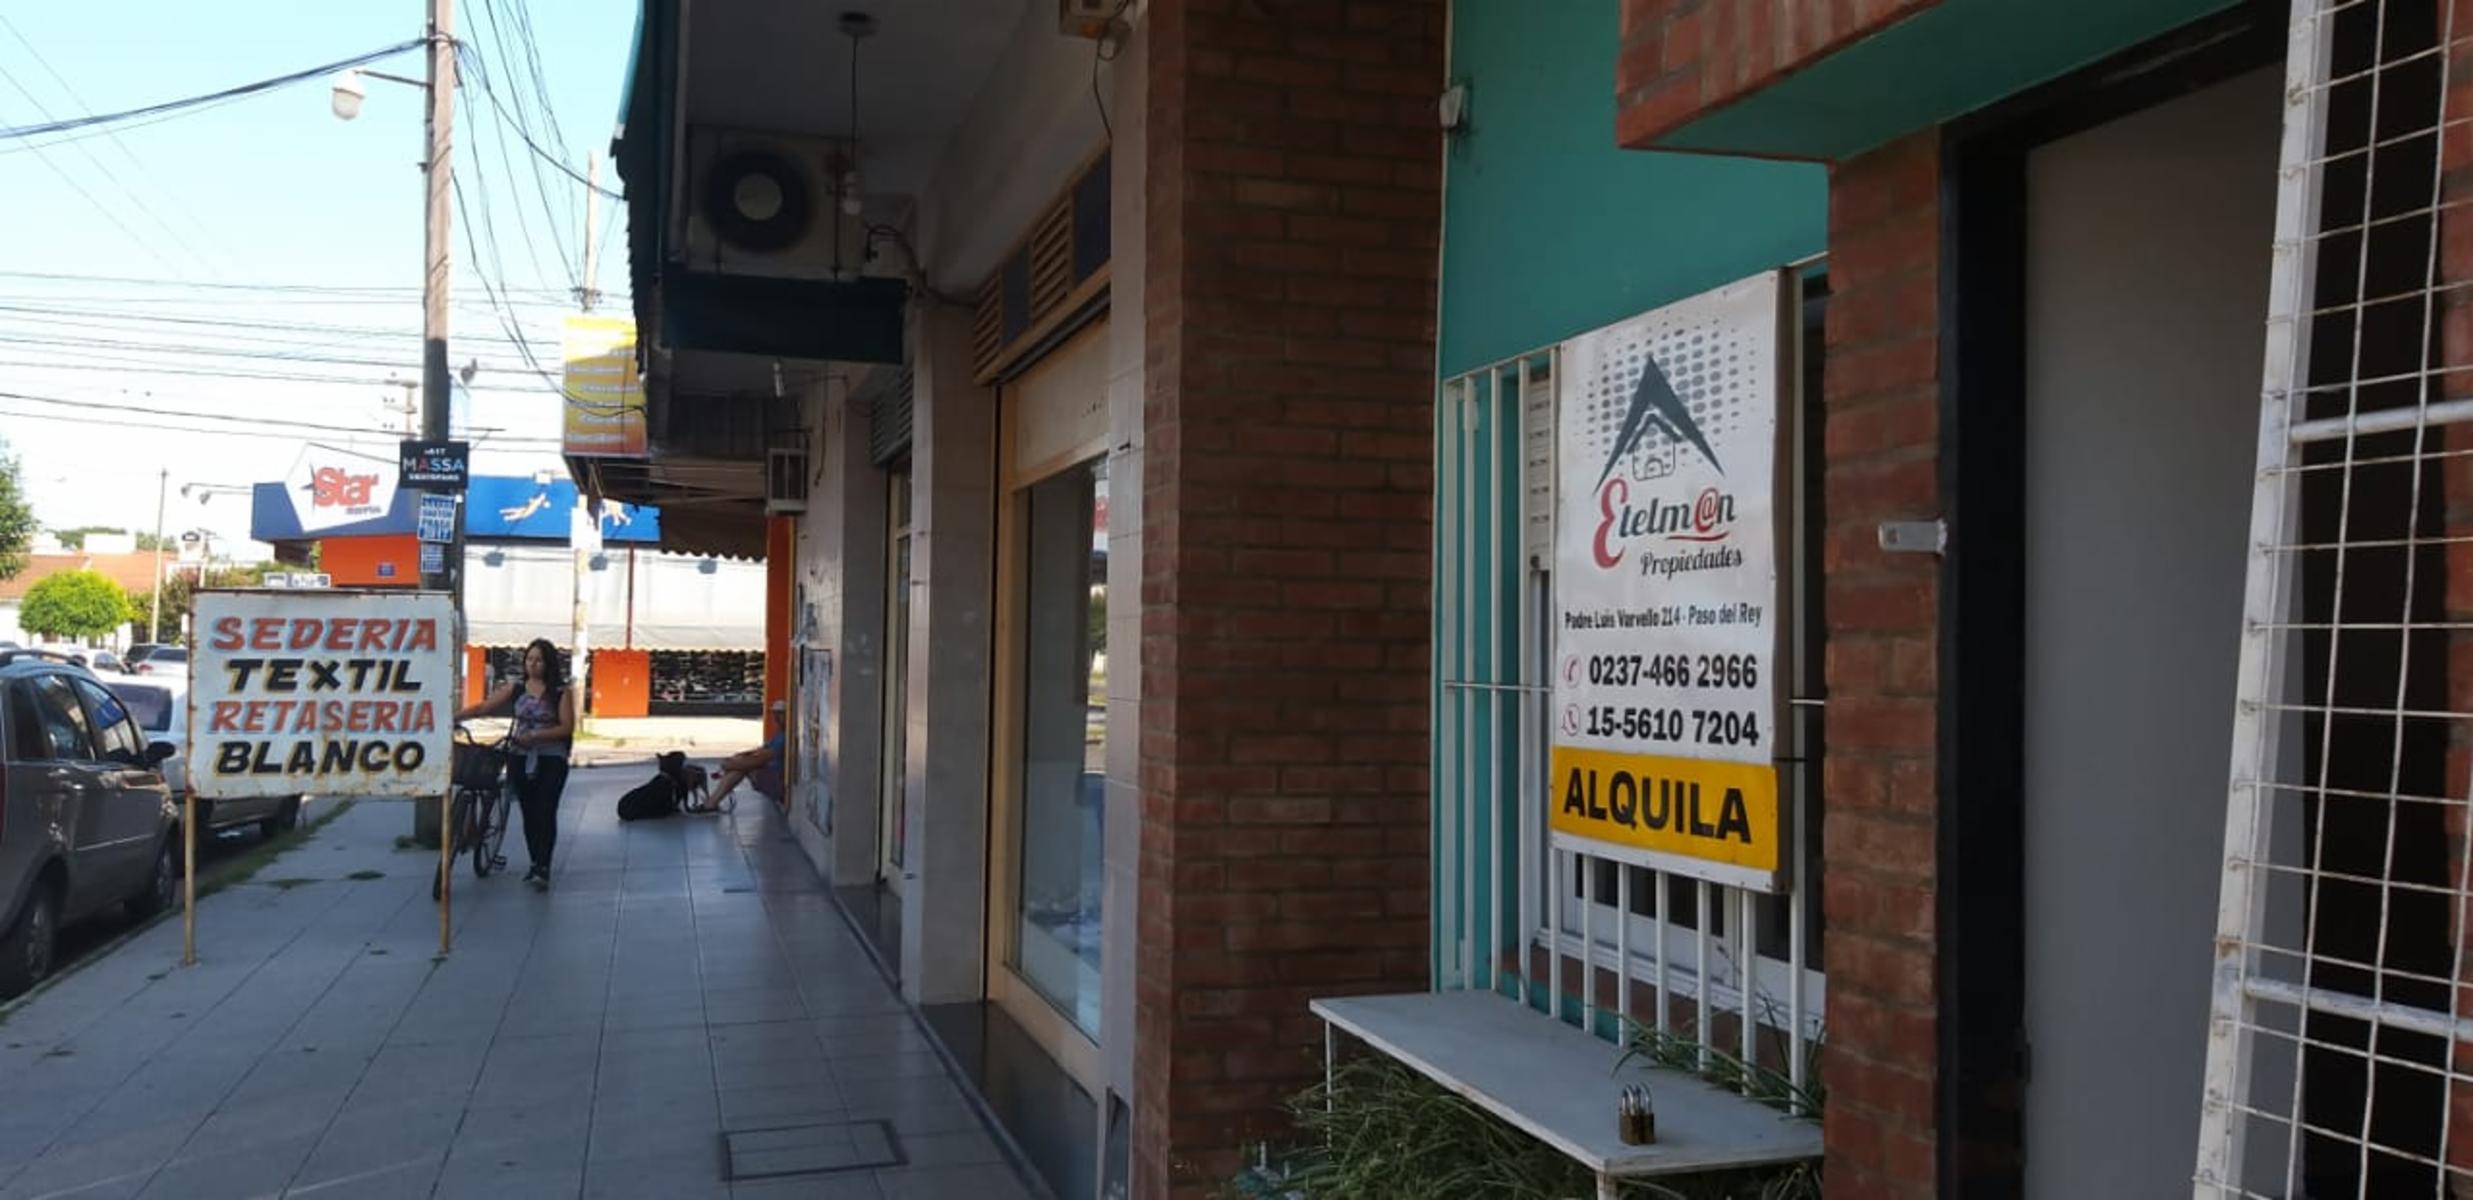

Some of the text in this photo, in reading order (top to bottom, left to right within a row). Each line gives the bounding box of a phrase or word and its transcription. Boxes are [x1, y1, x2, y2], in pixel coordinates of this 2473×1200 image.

[402, 457, 465, 473] MASSA
[313, 466, 379, 507] Star
[1640, 545, 1743, 580] Propiedades
[1565, 610, 1592, 629] Padre
[1595, 607, 1614, 628] Luis
[1661, 605, 1681, 626] 214
[1688, 604, 1716, 625] Paso
[1718, 602, 1738, 624] del
[1740, 602, 1763, 628] Rey
[209, 616, 437, 652] SEDERIA
[225, 658, 422, 693] TEXTIL
[1589, 654, 1758, 688] 0237-466 2966
[207, 699, 436, 736] RETASERIA
[1587, 706, 1760, 747] 15-5610 7204
[215, 740, 426, 776] BLANCO
[1563, 767, 1752, 844] ALQUILA
